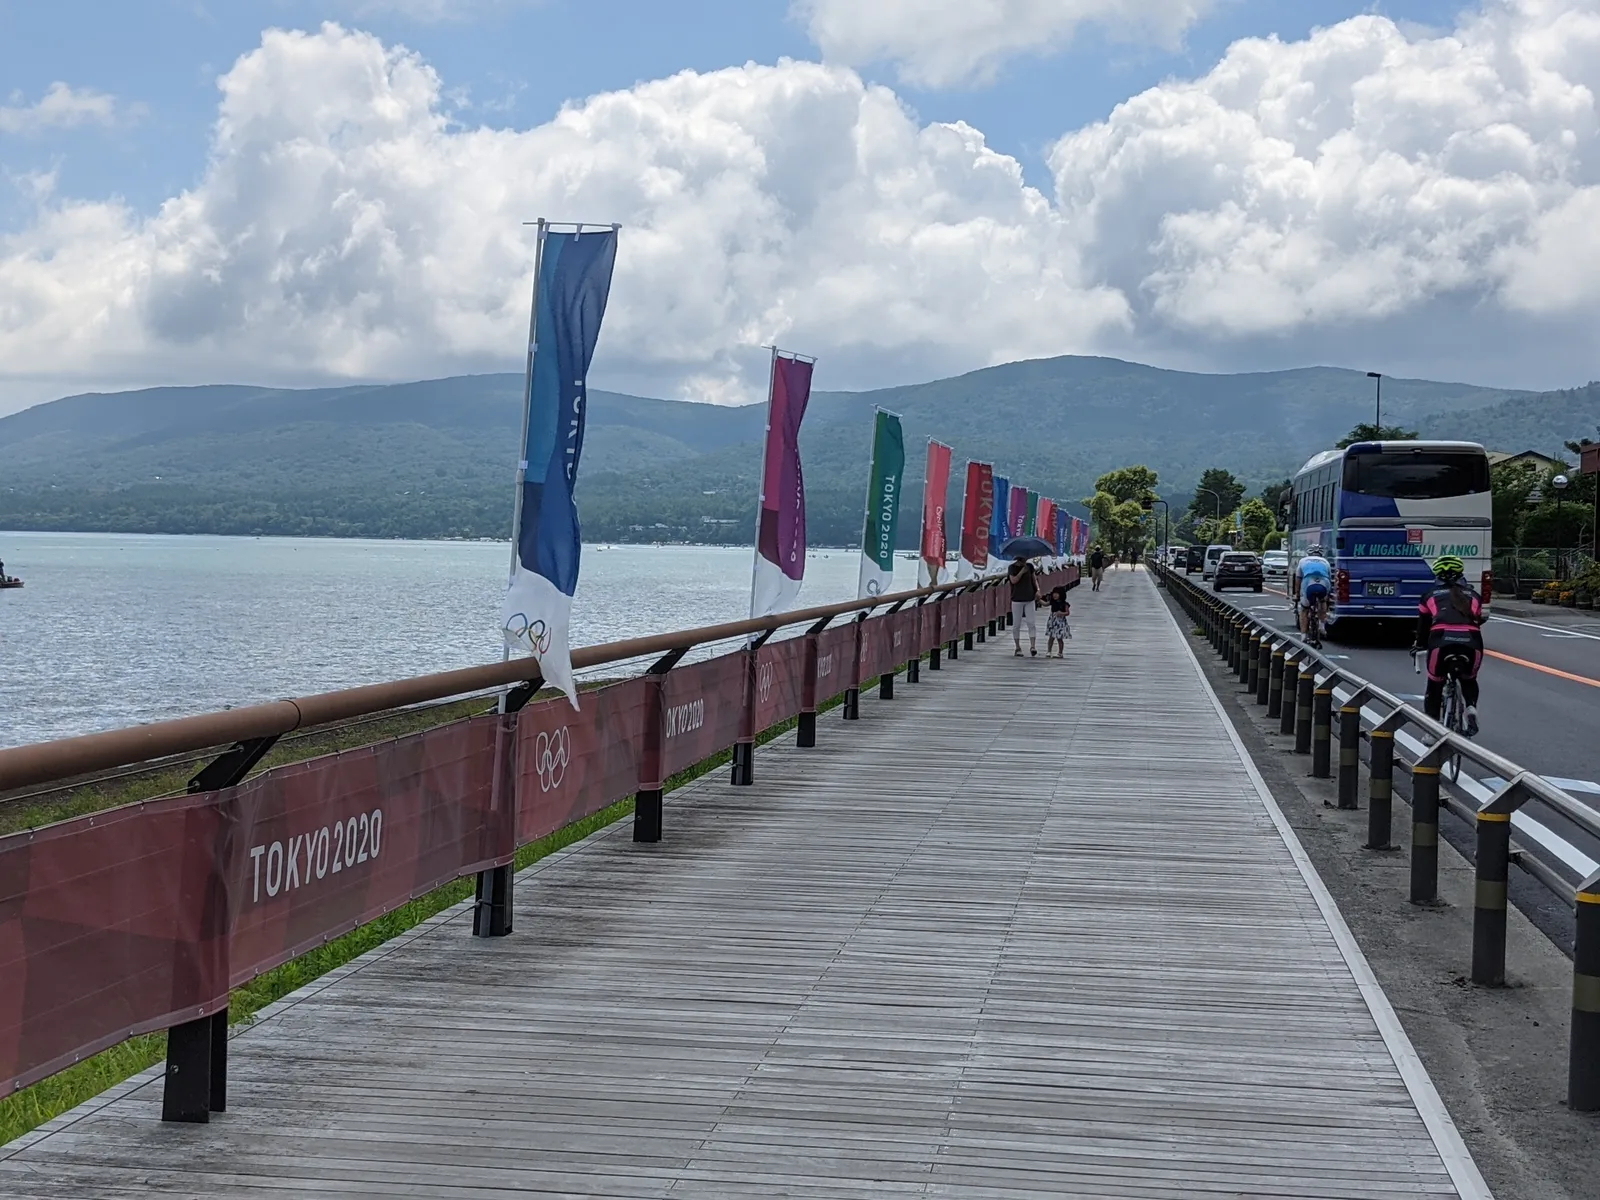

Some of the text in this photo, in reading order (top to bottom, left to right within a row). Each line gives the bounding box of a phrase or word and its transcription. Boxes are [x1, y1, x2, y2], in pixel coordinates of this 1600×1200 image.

[879, 475, 896, 559] TOKYO 2020
[1369, 544, 1435, 556] HIGASHIFUJI
[1439, 544, 1478, 556] KANKO
[666, 698, 703, 738] OKYO 2020
[250, 808, 382, 903] TOKYO 2020
